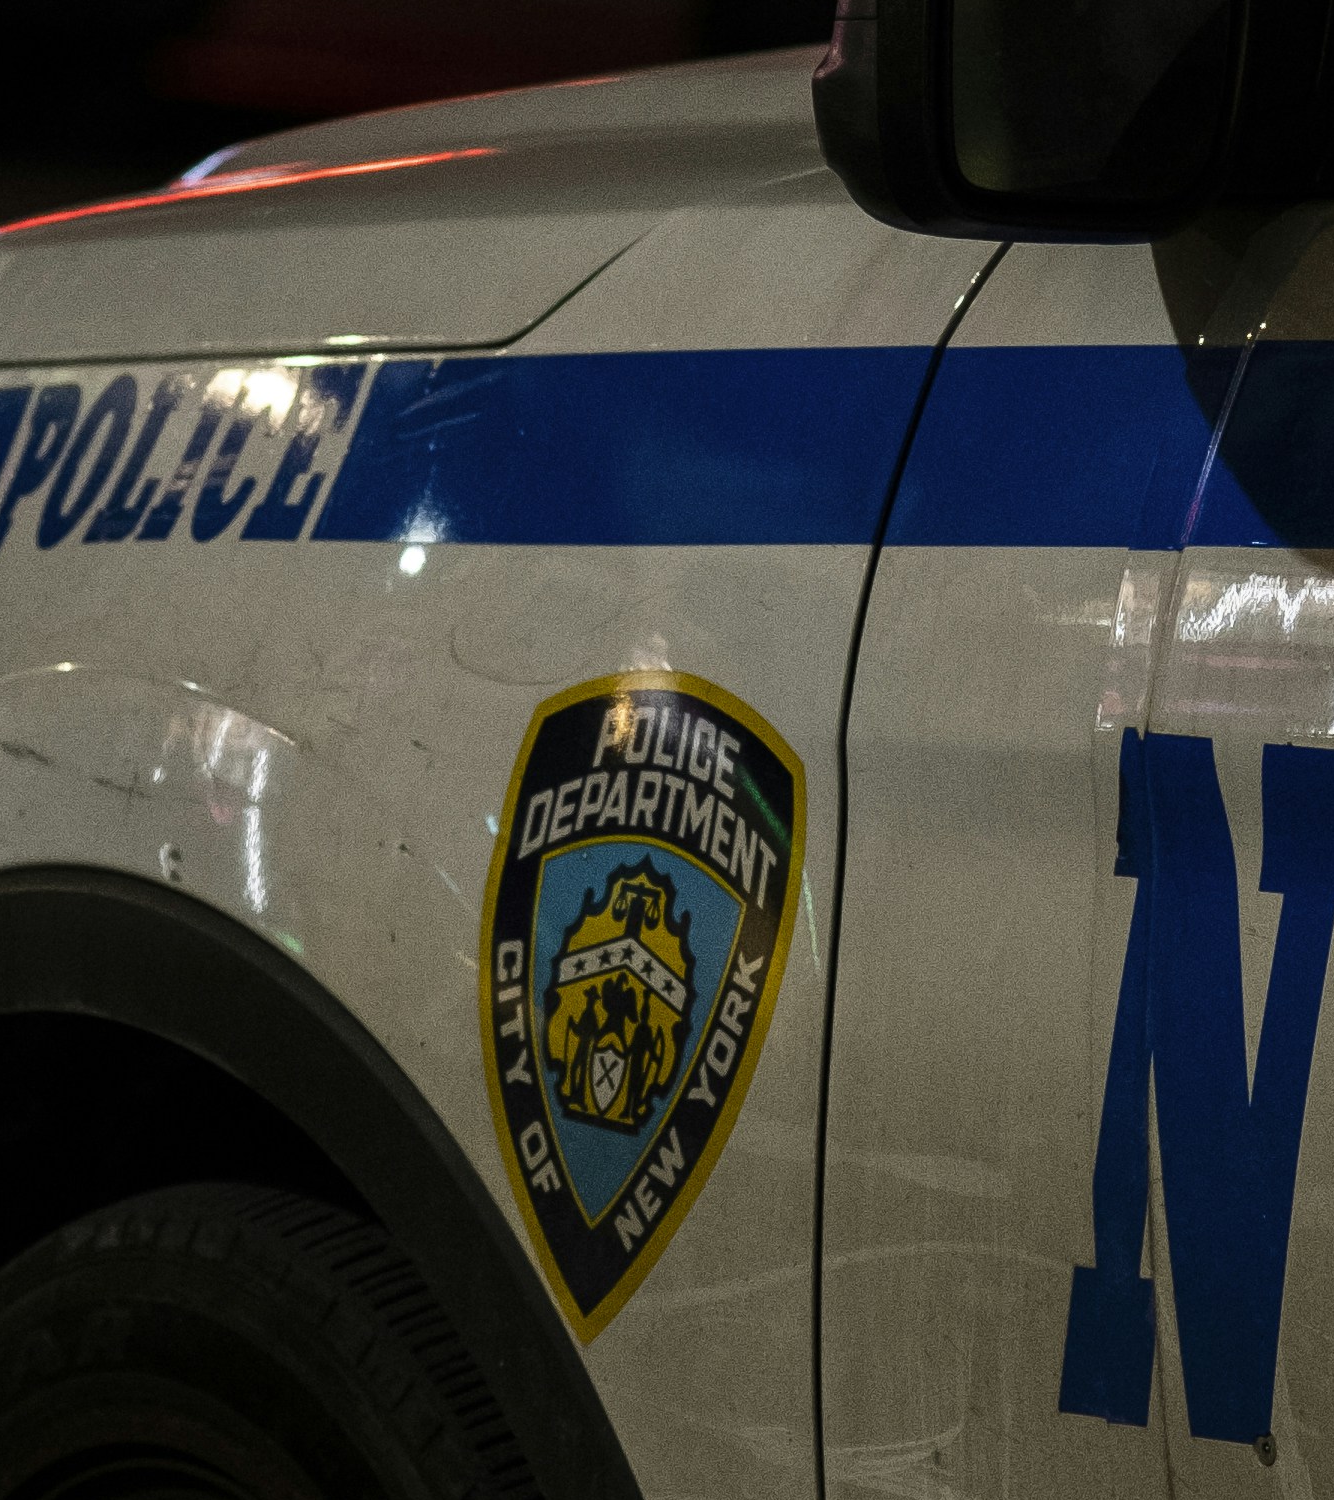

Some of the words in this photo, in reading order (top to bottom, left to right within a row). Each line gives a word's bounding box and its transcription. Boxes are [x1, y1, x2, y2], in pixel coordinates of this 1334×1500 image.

[518, 770, 778, 910] DEPARTMENT
[592, 705, 742, 800] POLICE
[494, 938, 534, 1087] CITY
[518, 1120, 562, 1197] OF
[612, 1125, 687, 1254] NEW
[687, 950, 765, 1109] YORK
